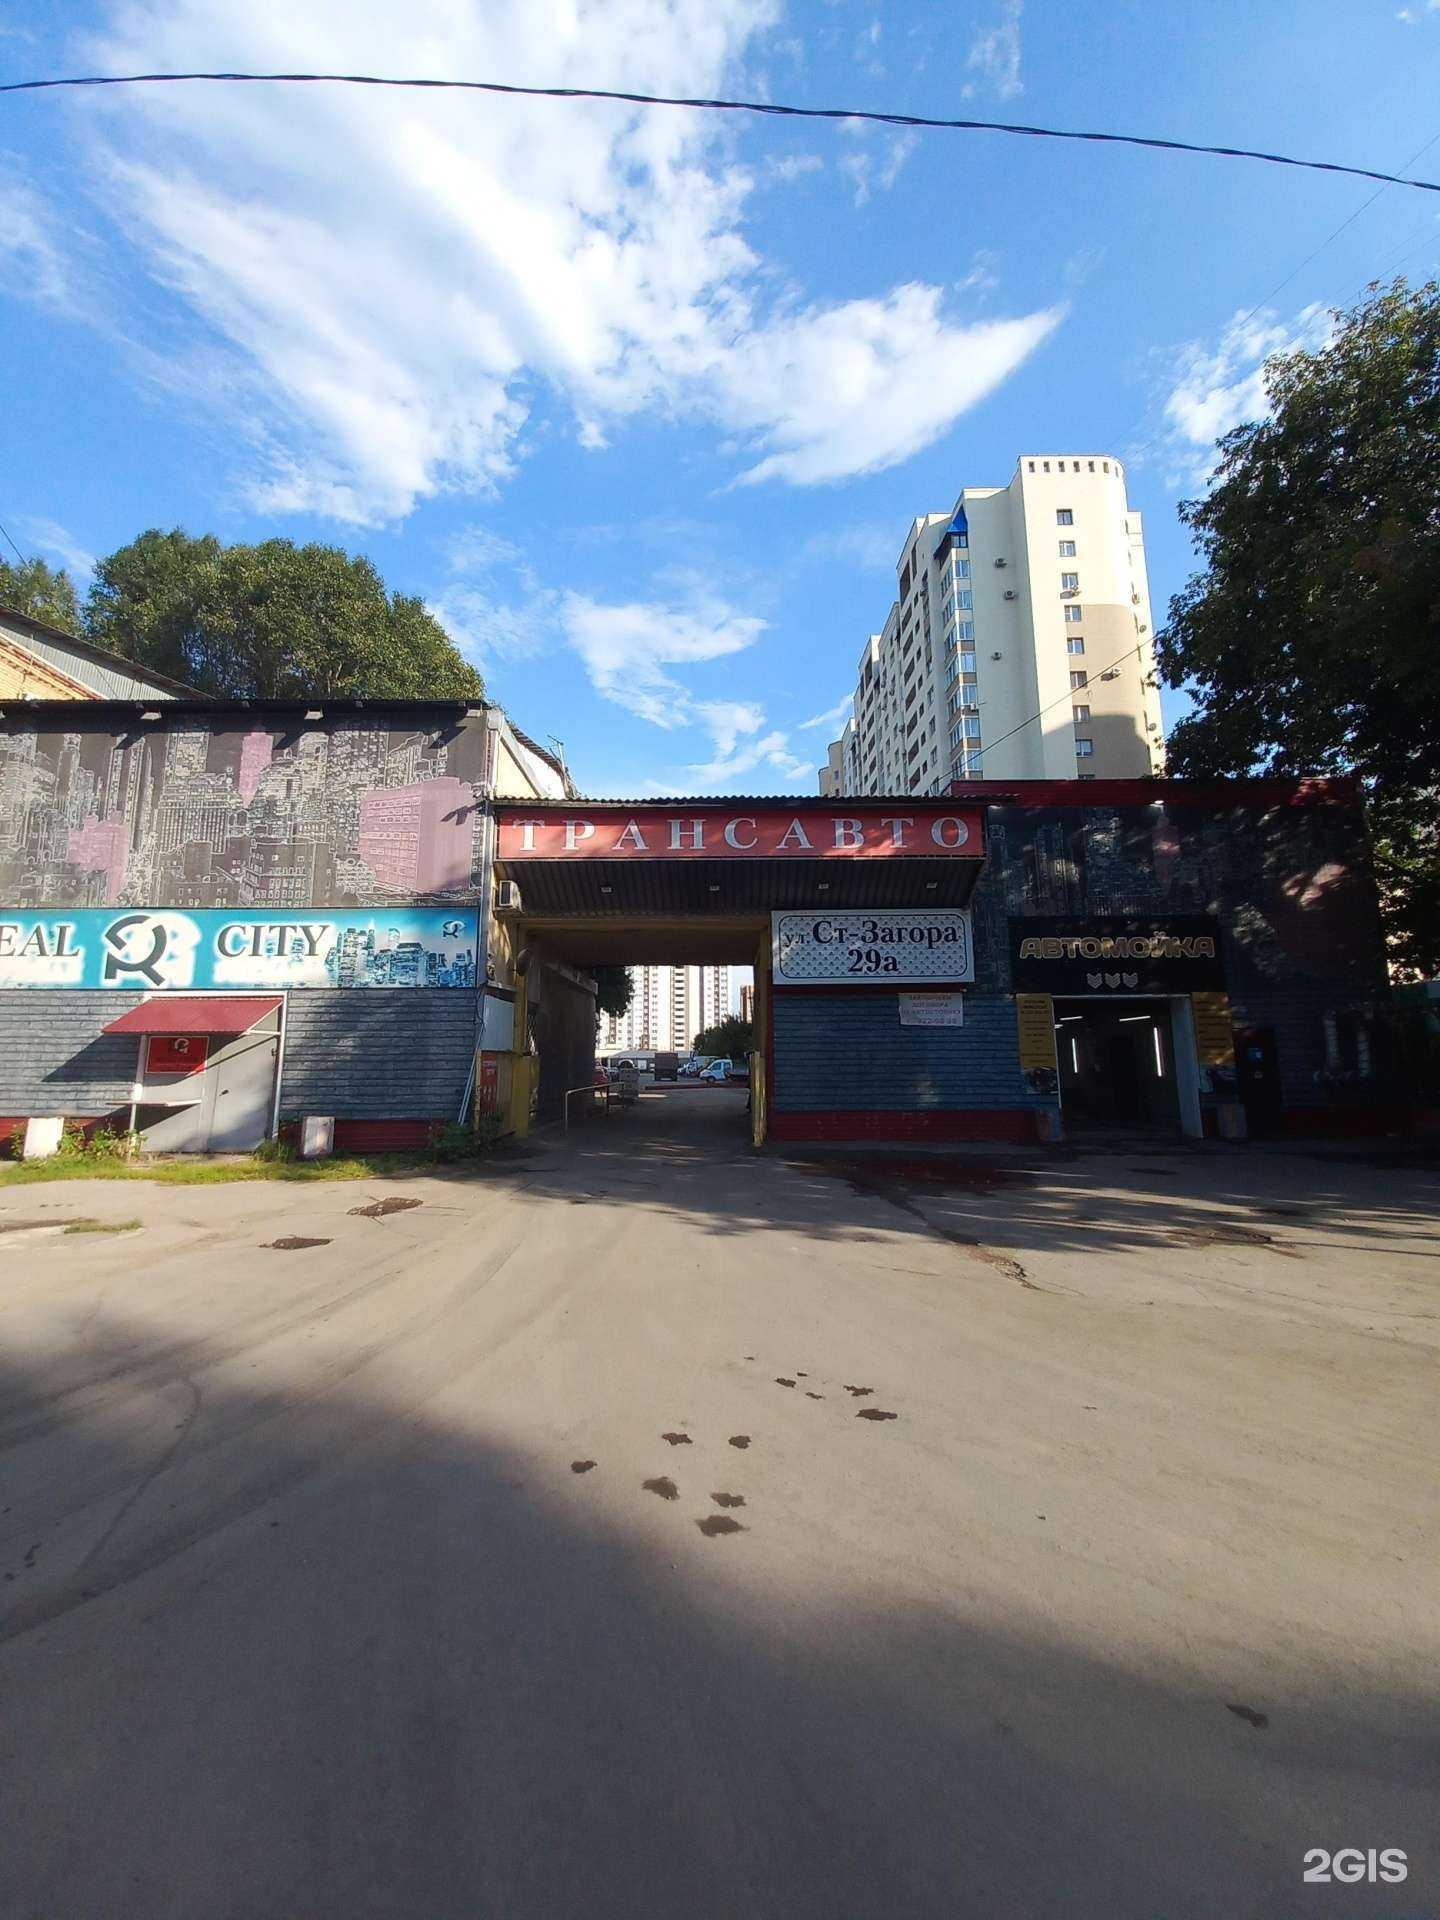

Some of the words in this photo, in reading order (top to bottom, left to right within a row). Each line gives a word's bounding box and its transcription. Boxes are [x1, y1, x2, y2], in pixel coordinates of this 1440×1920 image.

[512, 817, 969, 851] ТРАНСАВТО
[217, 924, 331, 958] CITY
[784, 933, 810, 947] ул.
[812, 920, 959, 949] Ст-Загора
[1019, 931, 1215, 959] АВТОМОЙКА
[848, 949, 899, 973] 29а
